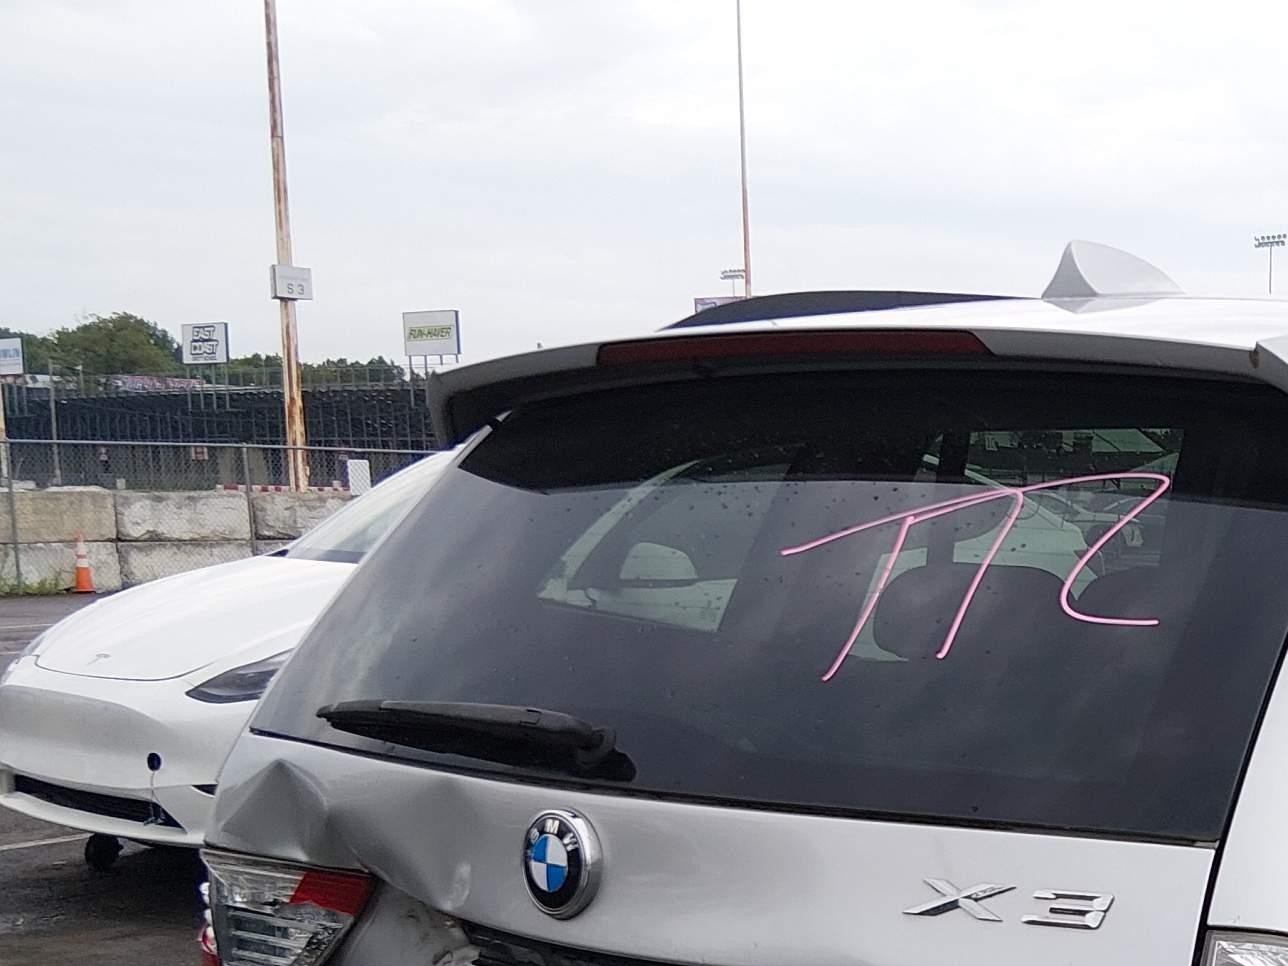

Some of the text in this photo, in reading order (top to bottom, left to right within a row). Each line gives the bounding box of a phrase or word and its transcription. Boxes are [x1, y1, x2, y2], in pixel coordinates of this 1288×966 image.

[192, 325, 216, 340] EAST
[190, 340, 219, 355] COAST
[527, 818, 580, 853] BMW
[902, 876, 1116, 931] X3
